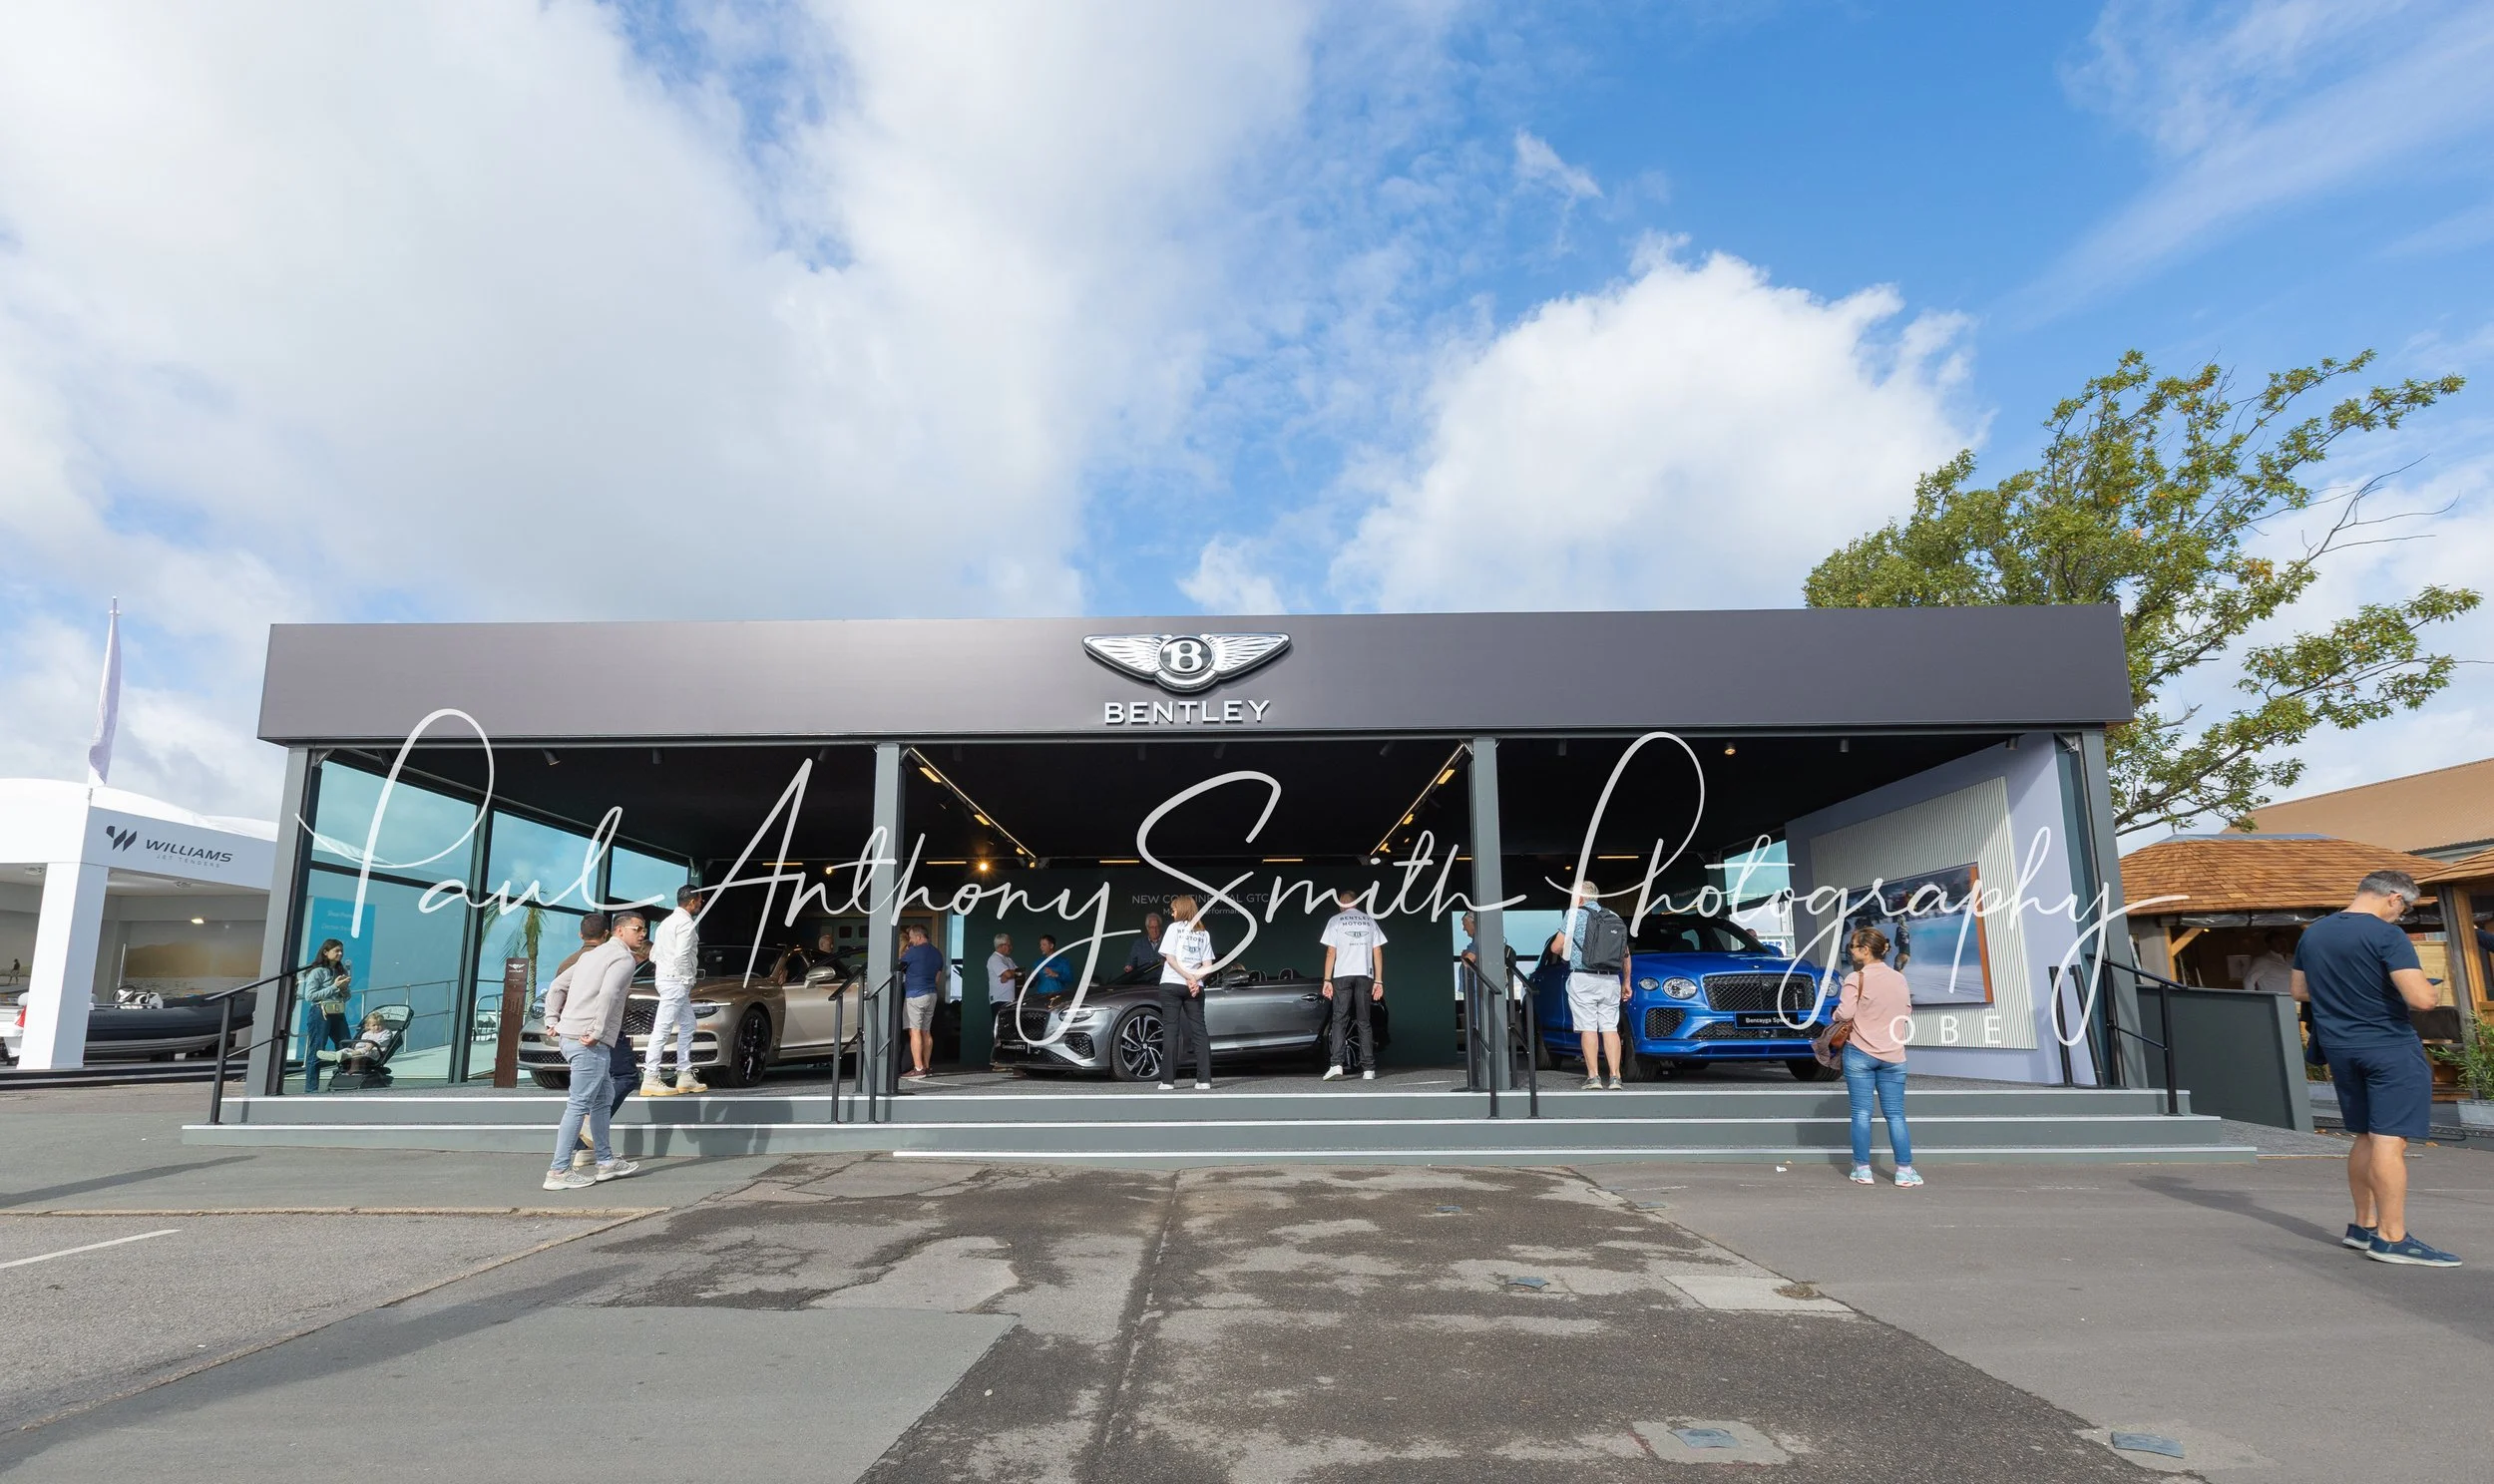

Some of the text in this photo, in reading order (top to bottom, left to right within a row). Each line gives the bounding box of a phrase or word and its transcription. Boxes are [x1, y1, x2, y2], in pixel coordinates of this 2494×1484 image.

[1104, 699, 1270, 724] BENTLEY
[146, 839, 233, 863] WILLIAMS
[1131, 895, 1159, 904] NEW
[1246, 894, 1269, 903] GTC
